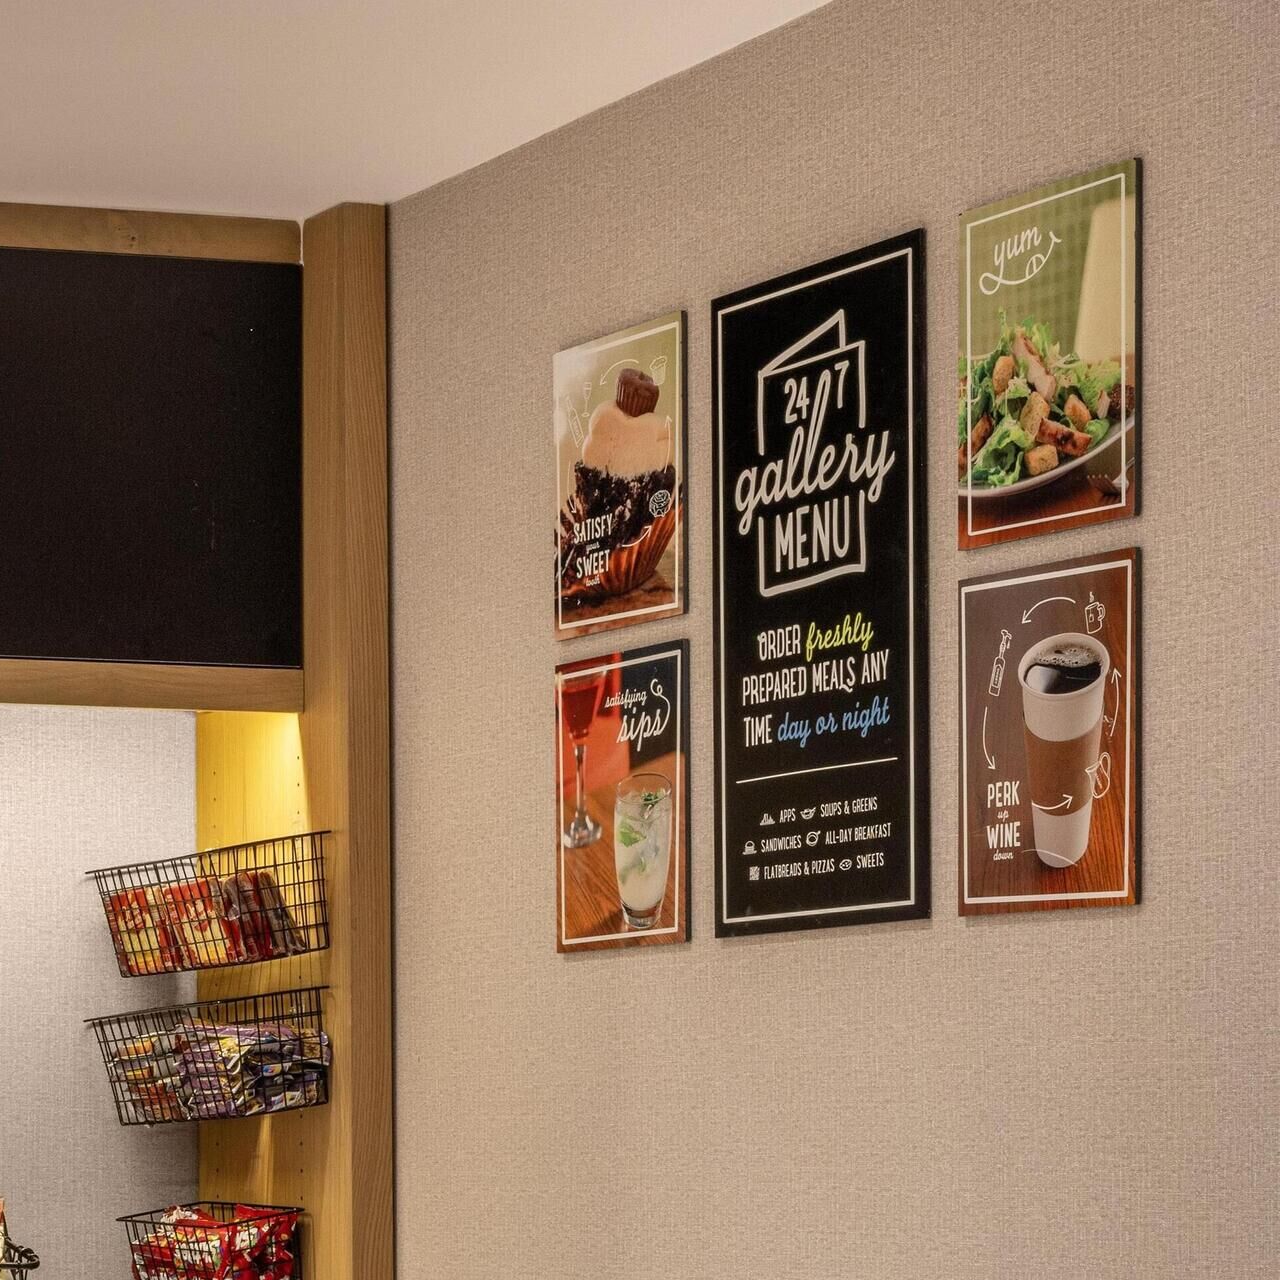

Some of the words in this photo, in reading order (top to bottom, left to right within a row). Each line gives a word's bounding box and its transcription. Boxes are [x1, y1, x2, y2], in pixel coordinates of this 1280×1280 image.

[784, 376, 809, 424] 24
[735, 369, 895, 535] gallery
[573, 513, 613, 544] SATISFY
[775, 495, 849, 573] MENU
[576, 549, 611, 579] SWEET
[757, 624, 801, 661] ORDER
[806, 612, 874, 662] freshly
[742, 666, 807, 706] PREPARED
[812, 656, 856, 693] MEALS
[861, 649, 889, 685] ANY
[605, 689, 647, 708] satisfying
[616, 702, 668, 751] sips
[744, 714, 772, 747] TIME
[777, 712, 811, 748] day
[815, 712, 838, 735] or
[842, 695, 890, 738] night
[779, 808, 796, 823] APPS
[820, 802, 842, 818] SOUPS
[844, 800, 850, 814] &
[852, 796, 878, 812] GREENS
[987, 780, 1020, 808] PERK
[997, 809, 1009, 823] up
[760, 835, 802, 853] SANDWICHES
[825, 828, 853, 845] ALL-DAY
[854, 822, 891, 840] BREAKFAST
[986, 821, 1021, 850] WINE
[764, 862, 802, 880] FLATBREADS
[803, 861, 810, 875] &
[811, 858, 835, 874] PIZZAS
[856, 852, 884, 869] SWEETS
[993, 849, 1014, 861] down
